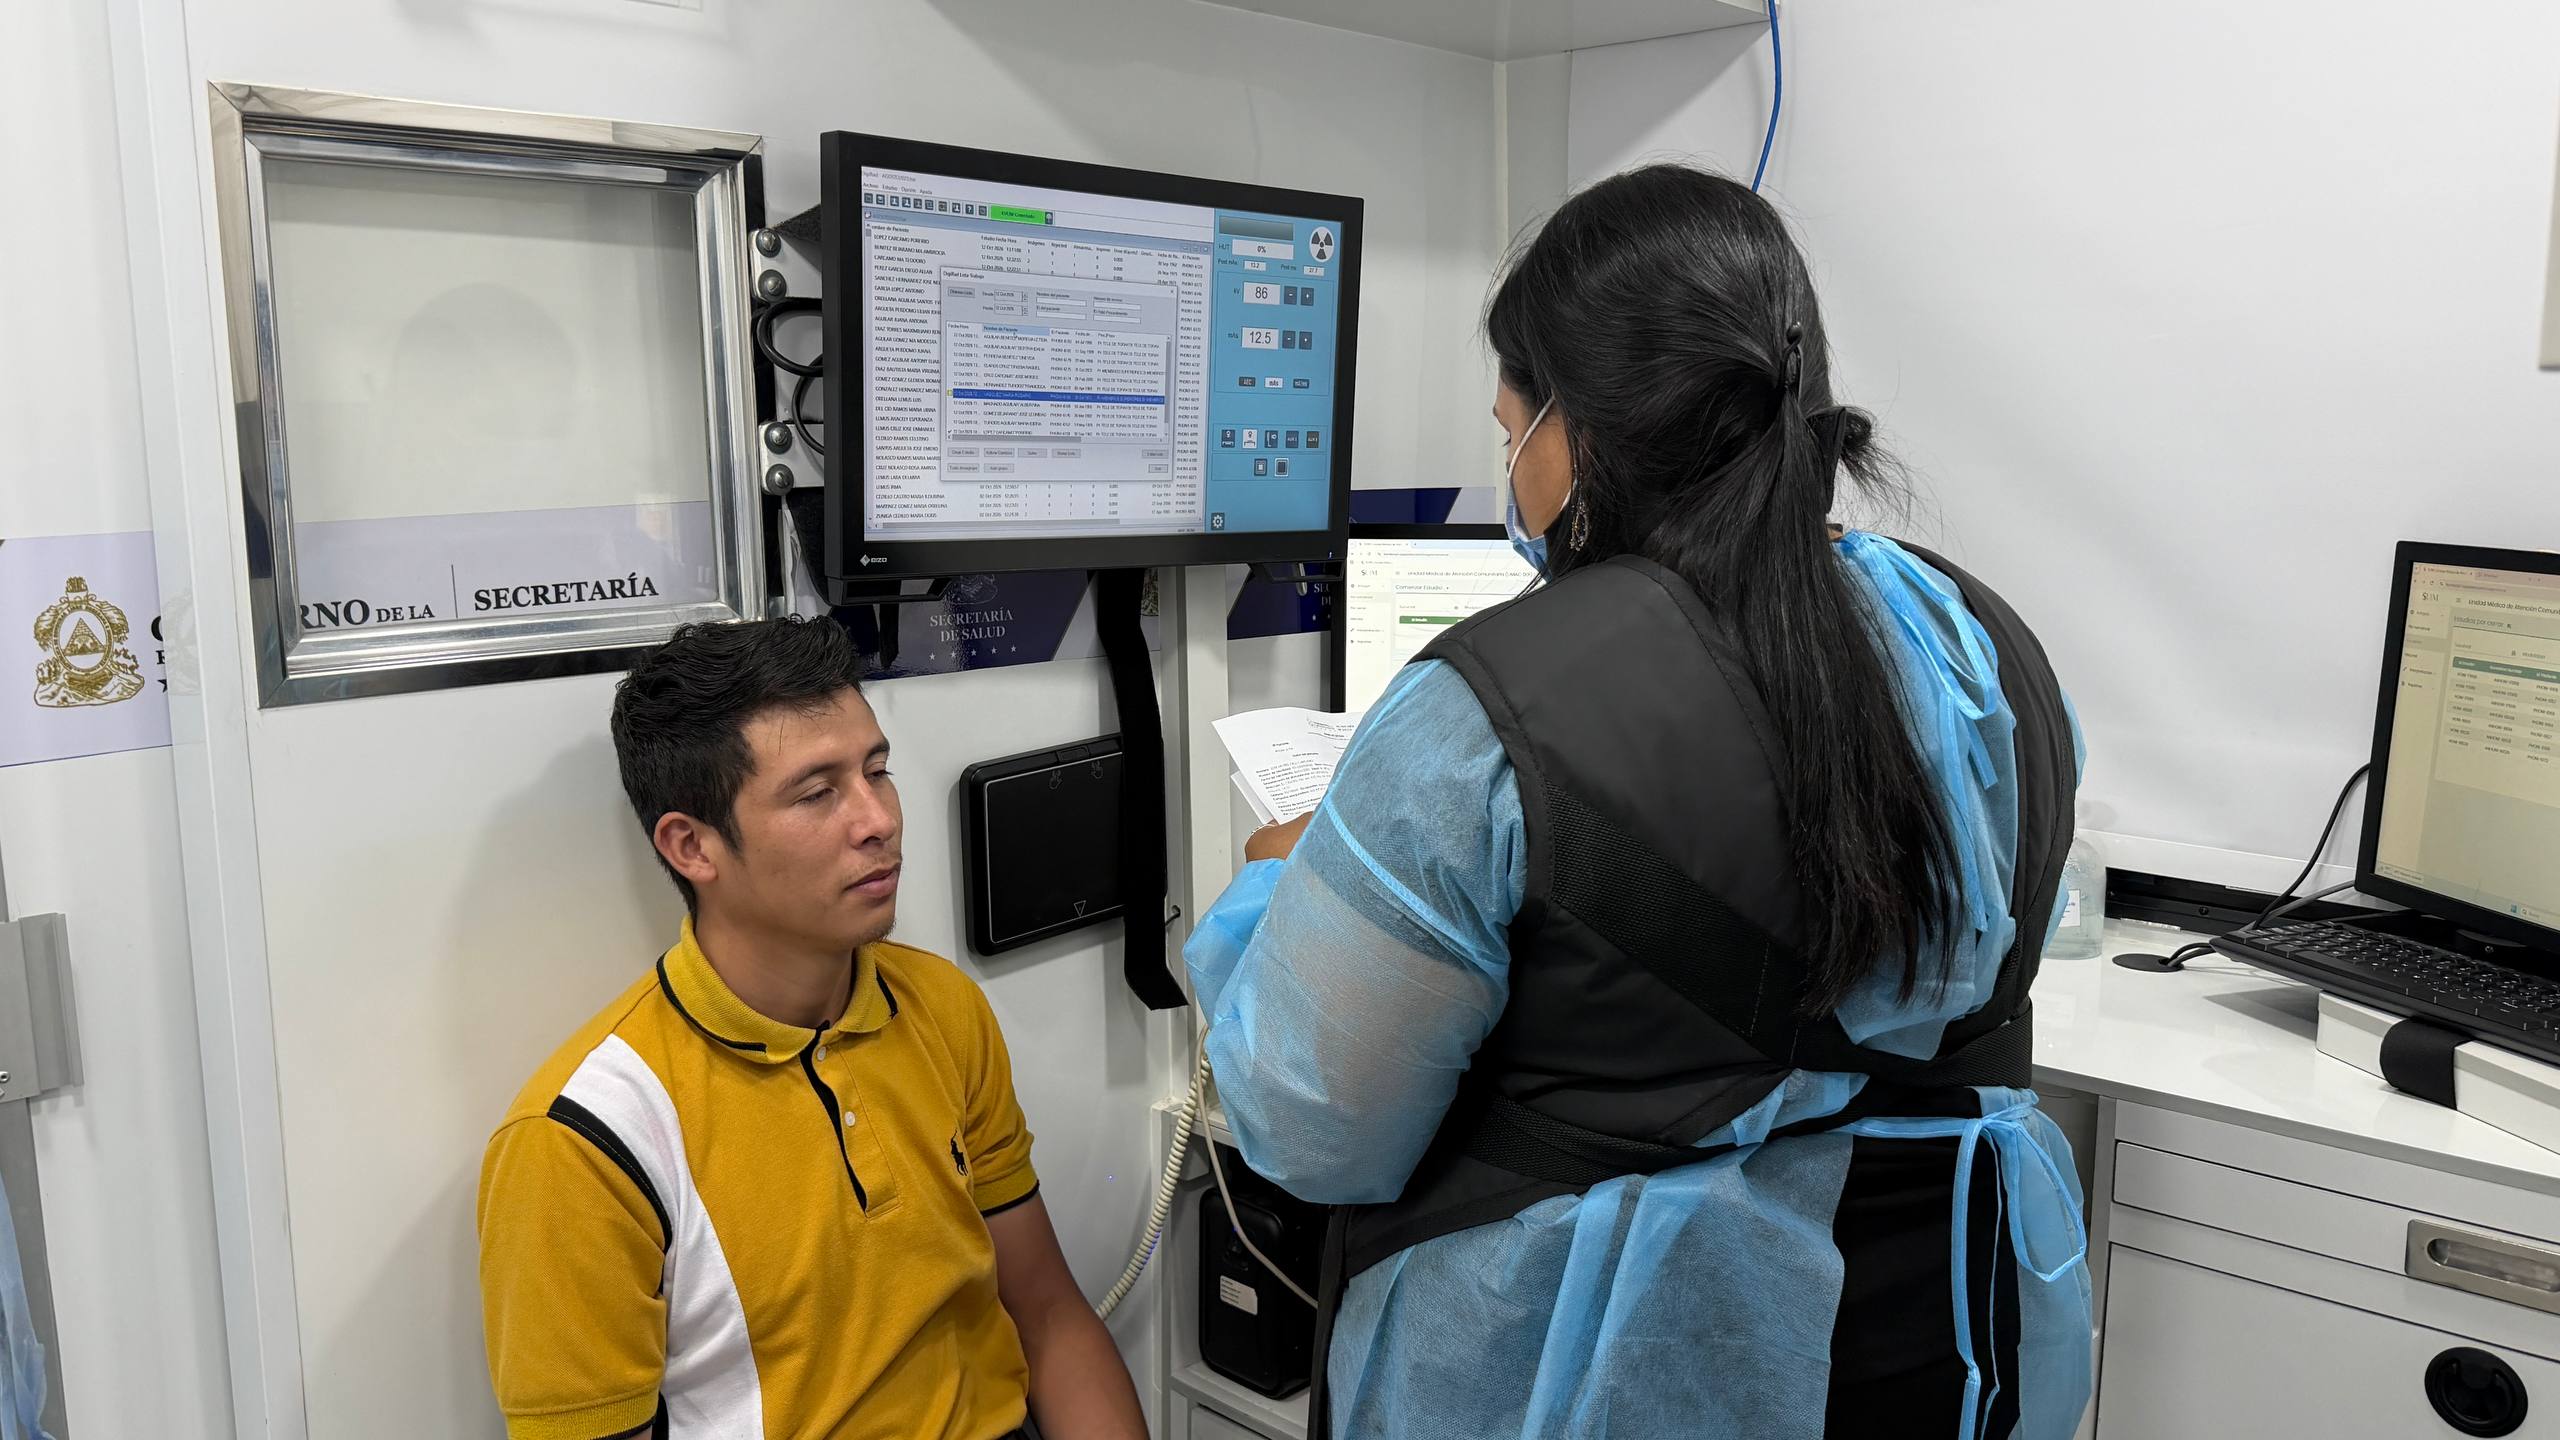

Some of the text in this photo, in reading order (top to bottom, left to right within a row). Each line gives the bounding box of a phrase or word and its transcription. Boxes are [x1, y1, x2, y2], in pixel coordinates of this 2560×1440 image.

[1256, 245, 1266, 253] 0%
[1254, 285, 1268, 299] 86
[1249, 330, 1271, 345] 12.5
[474, 572, 659, 611] SECRETARÍA
[376, 607, 404, 622] DE
[408, 604, 435, 619] LA
[929, 606, 1014, 627] SECRETARÍA
[940, 625, 1006, 642] DE SALUD
